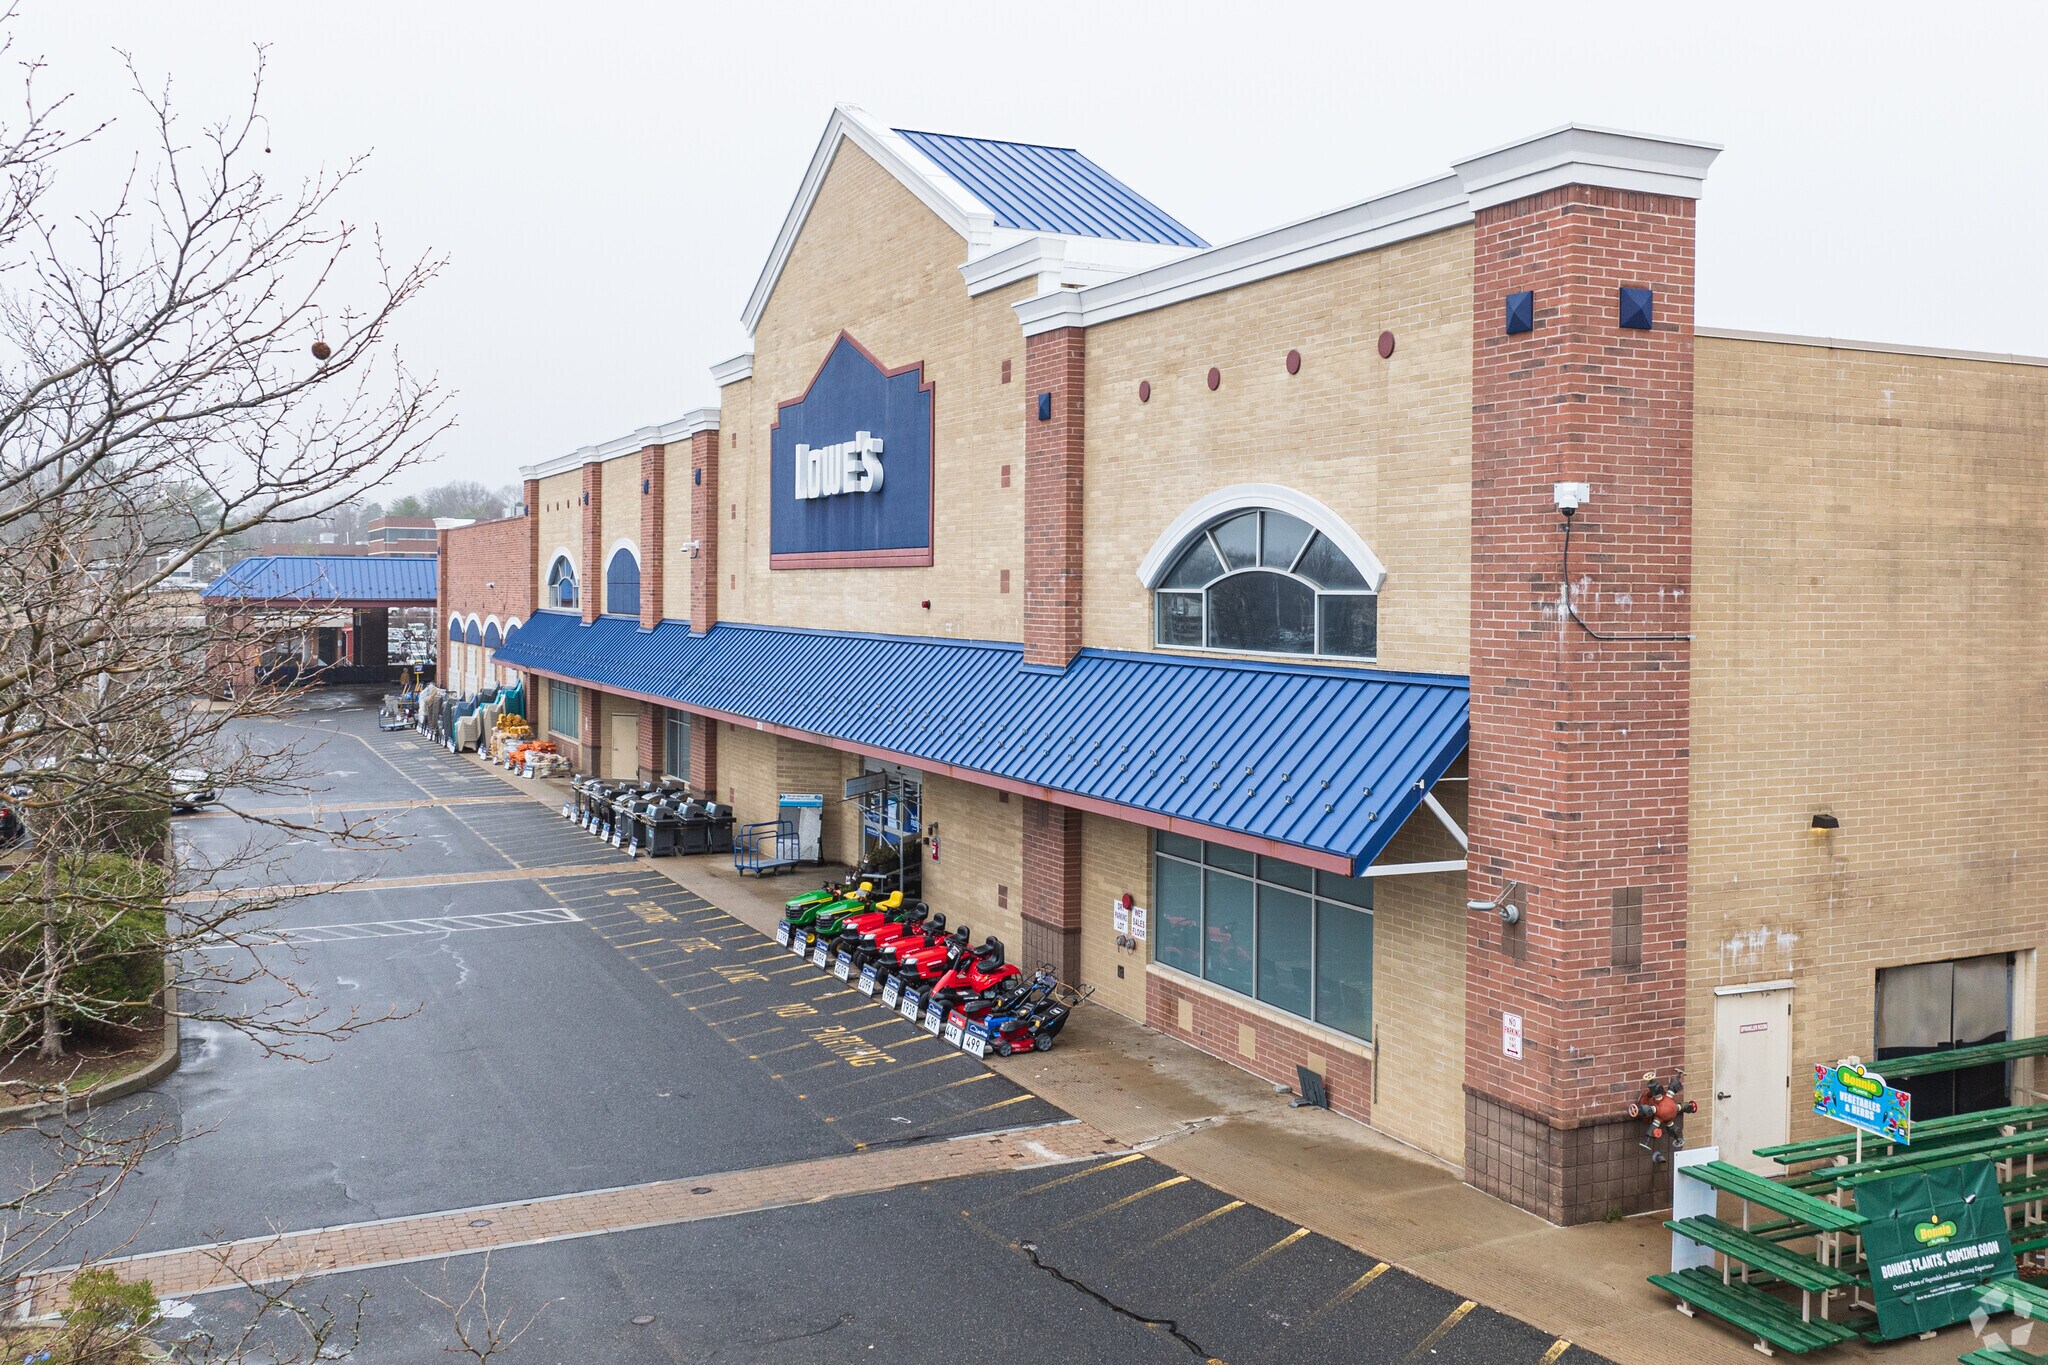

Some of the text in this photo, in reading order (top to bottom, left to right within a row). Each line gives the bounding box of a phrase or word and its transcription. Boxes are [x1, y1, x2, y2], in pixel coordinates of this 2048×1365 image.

[795, 431, 884, 500] LOWE'S
[903, 1001, 916, 1017] 1939
[926, 1016, 938, 1031] 499
[1509, 1017, 1516, 1027] NO
[945, 1024, 958, 1040] 449
[966, 1035, 981, 1052] 499
[1844, 1072, 1876, 1092] Bonnie
[1840, 1091, 1881, 1113] VEGETABLES
[1845, 1103, 1875, 1121] & HERBS
[1920, 1224, 1952, 1240] Bonnie
[1881, 1260, 1913, 1279] BONNIE
[1946, 1245, 1979, 1264] COMING
[1977, 1240, 2000, 1257] SOON
